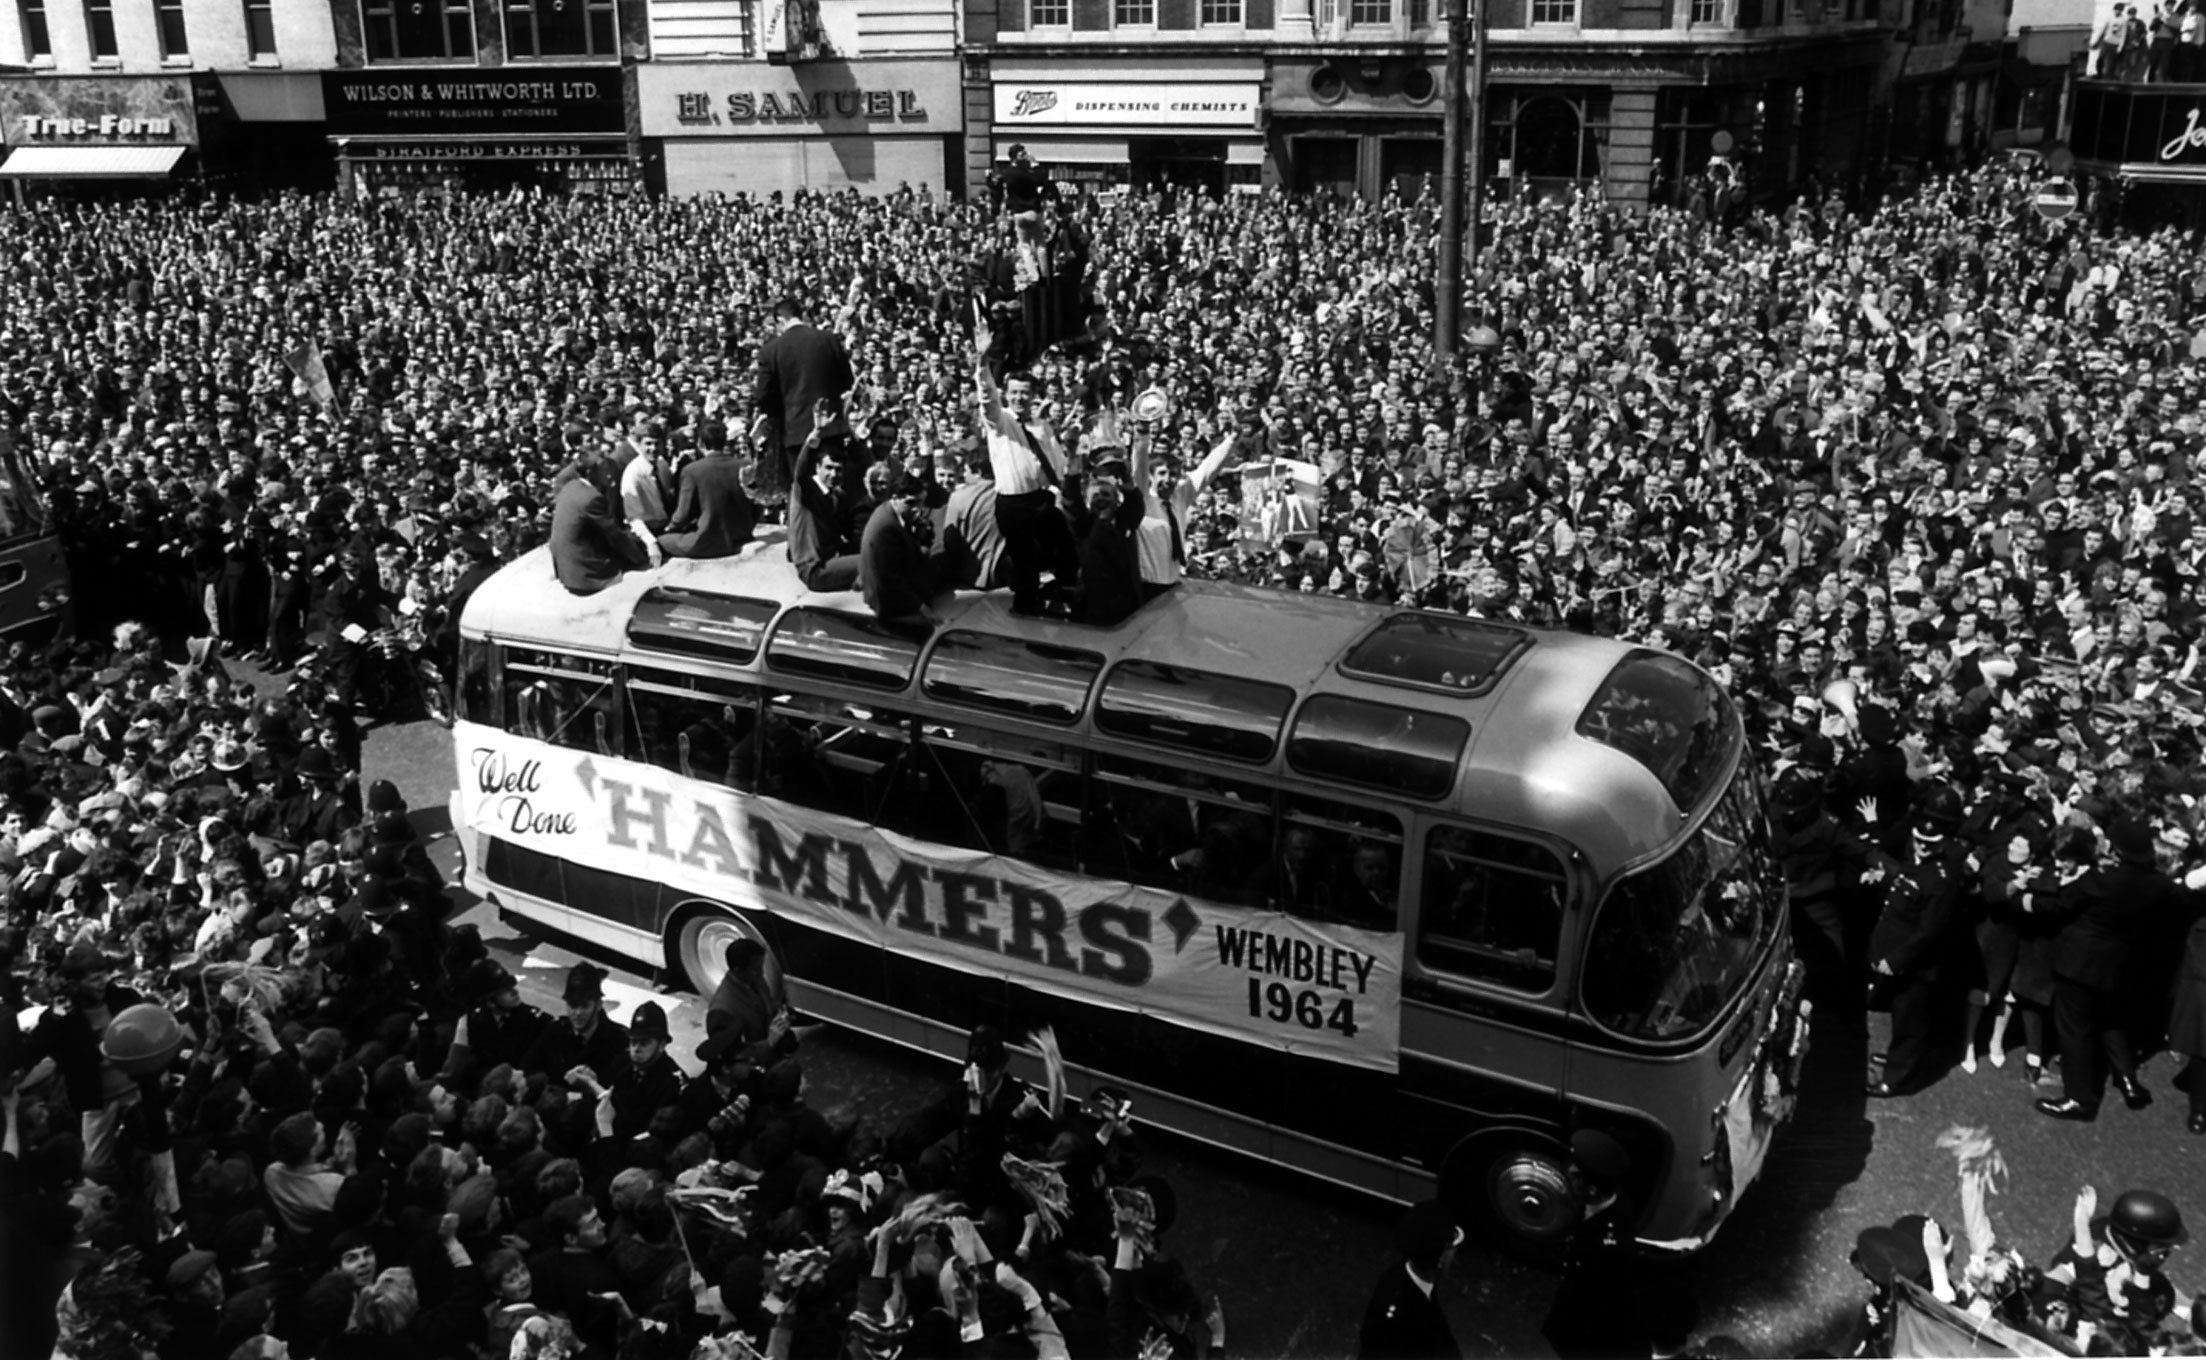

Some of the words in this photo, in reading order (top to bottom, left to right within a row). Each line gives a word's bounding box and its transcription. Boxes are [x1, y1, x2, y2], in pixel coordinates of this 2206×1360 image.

[343, 84, 414, 101] WILSON
[421, 84, 433, 100] &
[437, 82, 555, 100] WHITWORTH
[727, 89, 929, 125] SAMUEL
[1075, 102, 1161, 112] DISPENSING
[1170, 102, 1248, 112] CHEMISTS
[22, 114, 172, 135] True-Form
[494, 144, 581, 158] EXPRESS
[471, 748, 541, 793] Well
[497, 795, 577, 835] Done
[1216, 925, 1376, 994] WEMBLEY
[1248, 977, 1359, 1038] 1964
